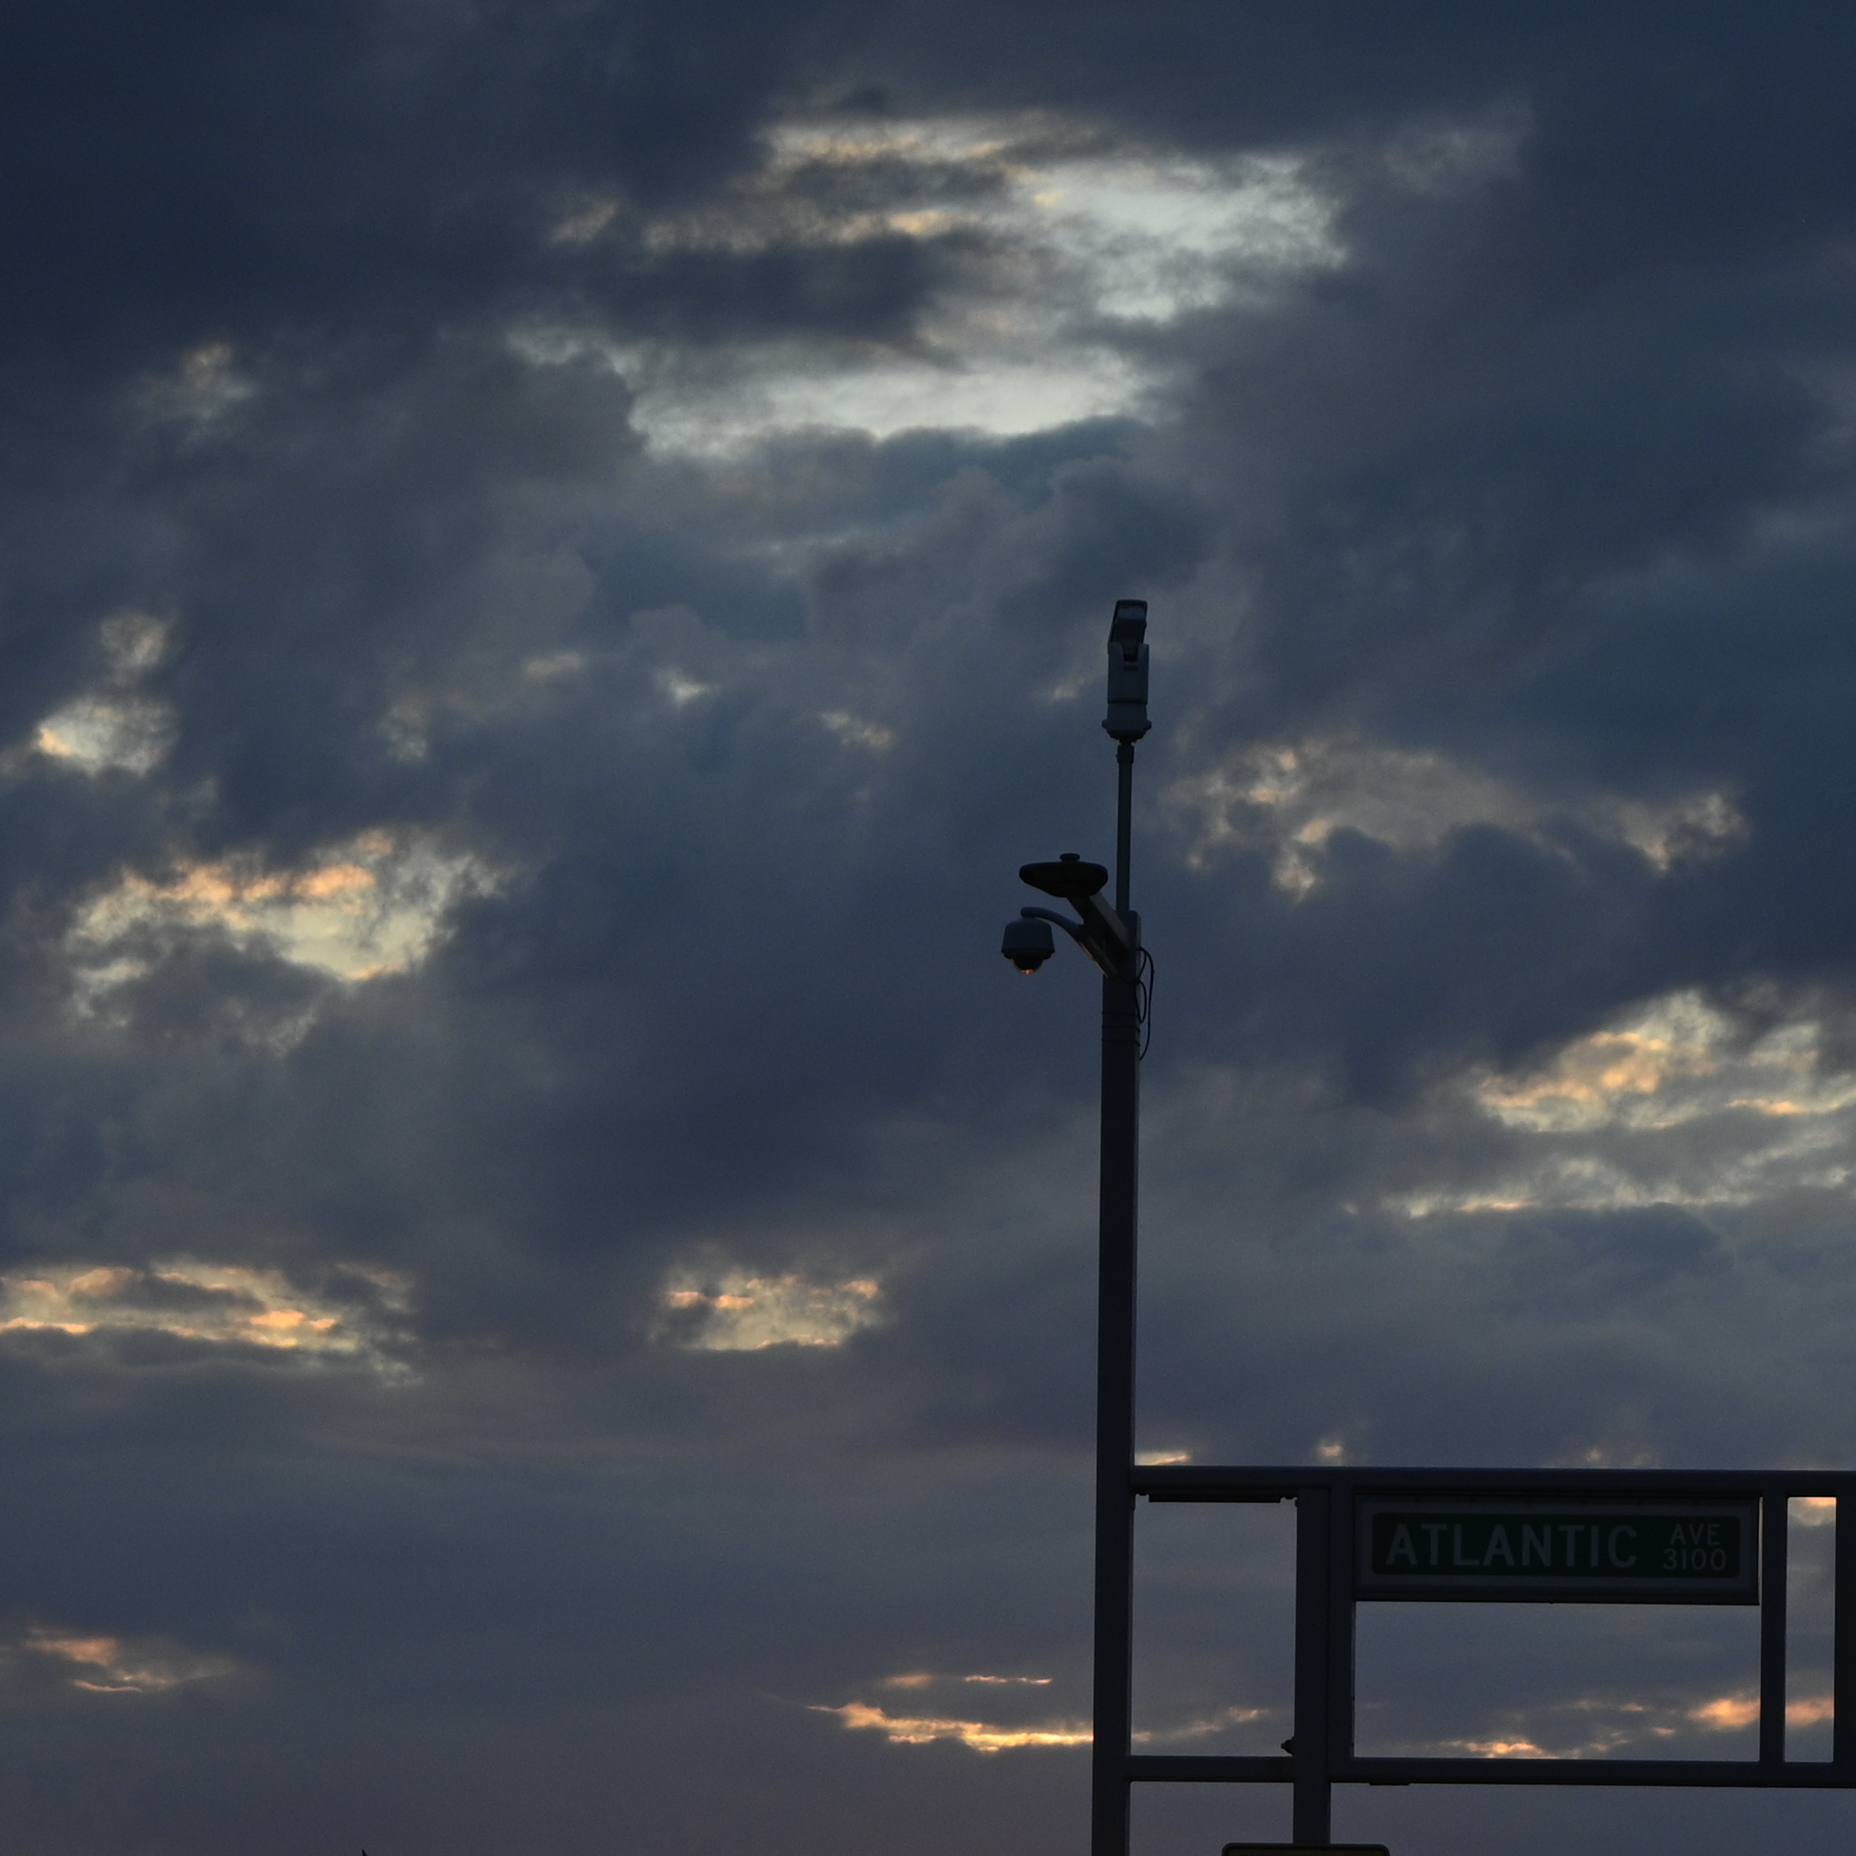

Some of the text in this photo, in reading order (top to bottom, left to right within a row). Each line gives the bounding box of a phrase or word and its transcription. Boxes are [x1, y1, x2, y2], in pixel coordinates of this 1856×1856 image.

[1385, 1522, 1721, 1569] ATLANTIC AVE
[1662, 1547, 1727, 1571] 3100
